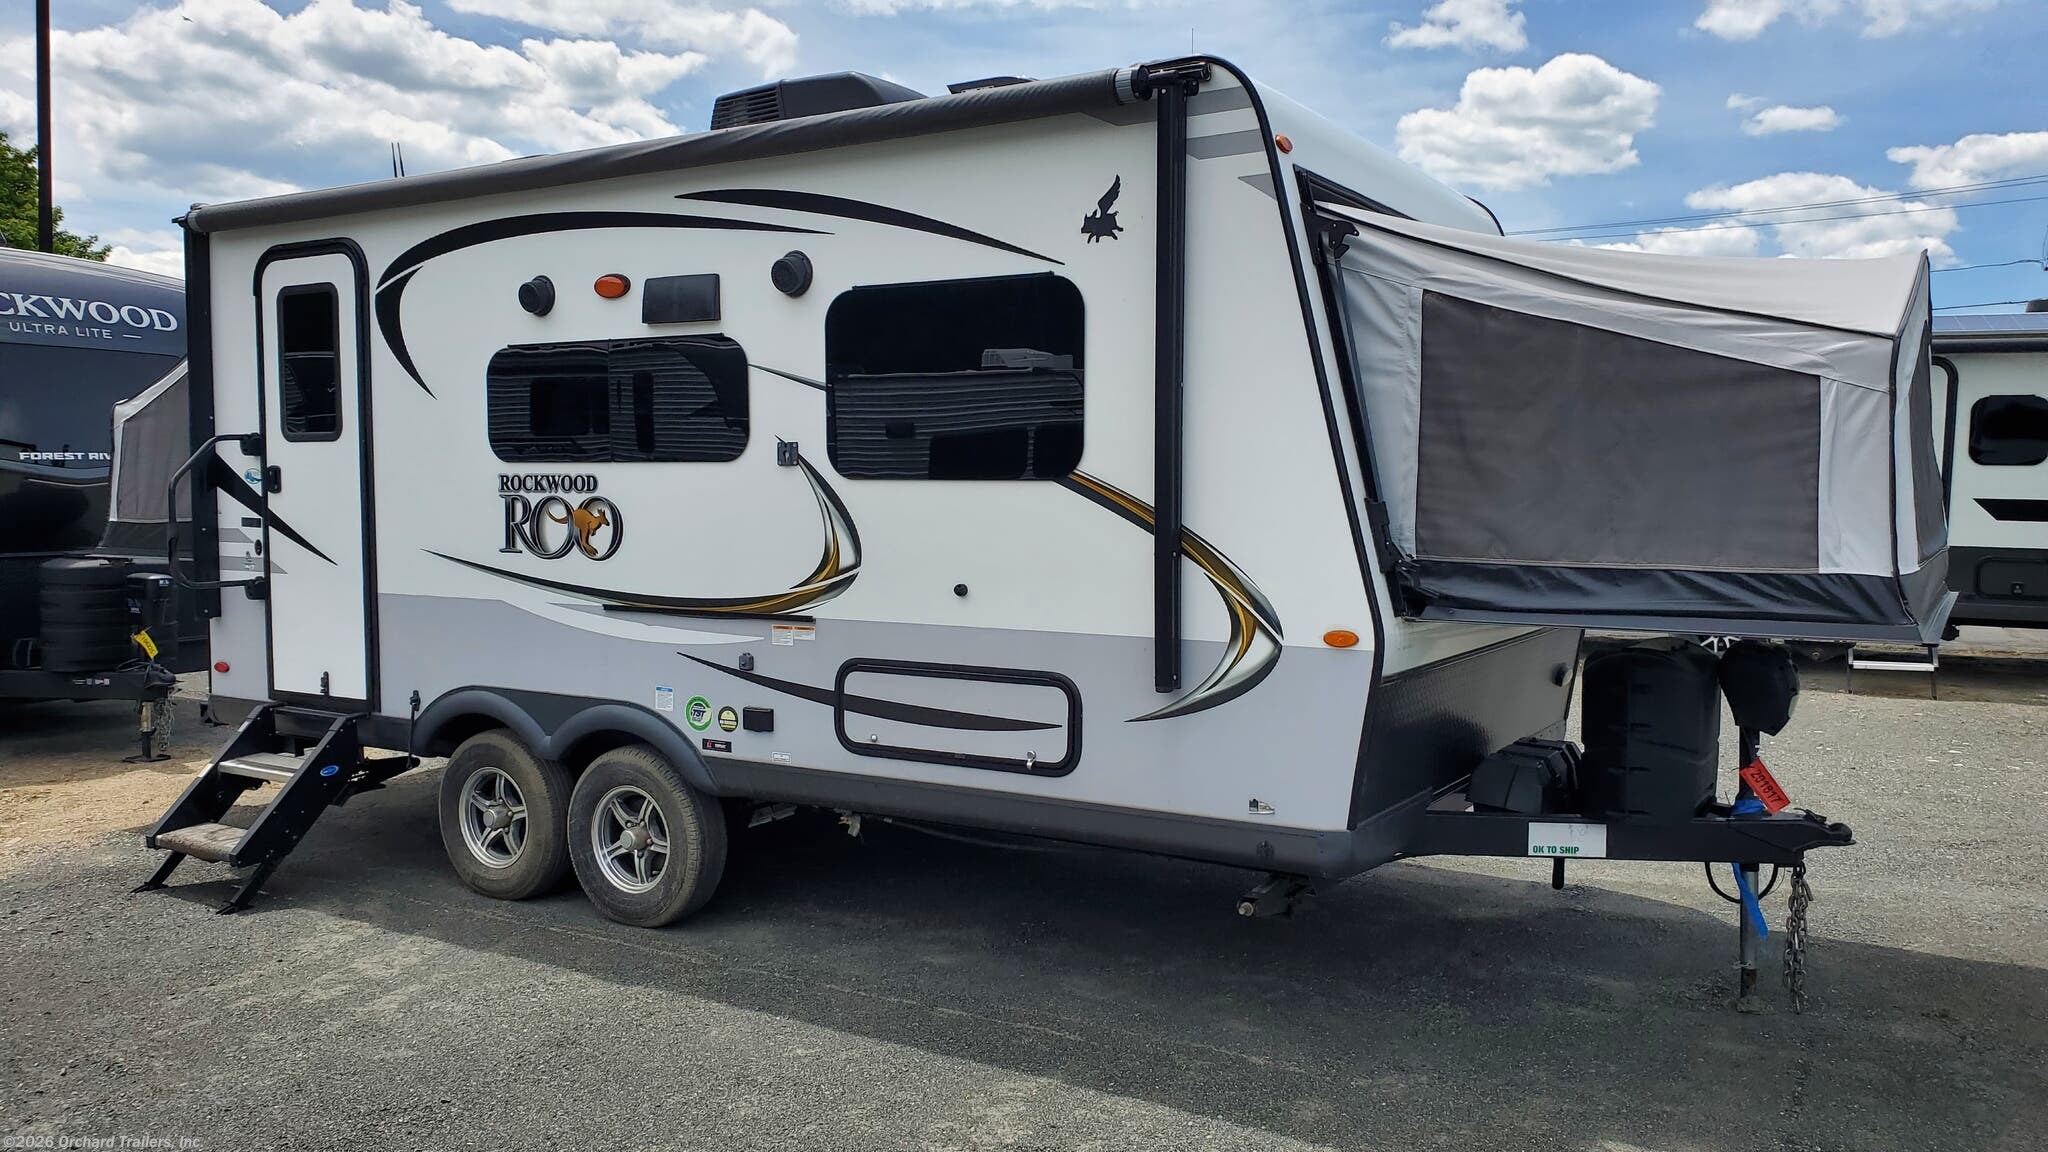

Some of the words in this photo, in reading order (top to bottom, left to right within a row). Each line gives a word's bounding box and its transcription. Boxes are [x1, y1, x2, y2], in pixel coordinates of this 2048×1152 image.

[9, 321, 69, 336] ULTRA
[75, 326, 113, 339] LITE
[19, 452, 85, 460] FOREST
[498, 473, 599, 493] ROCKWOOD
[498, 494, 624, 561] ROO
[1532, 845, 1545, 854] OK
[1546, 845, 1557, 854] TO
[1559, 846, 1580, 854] SHIP
